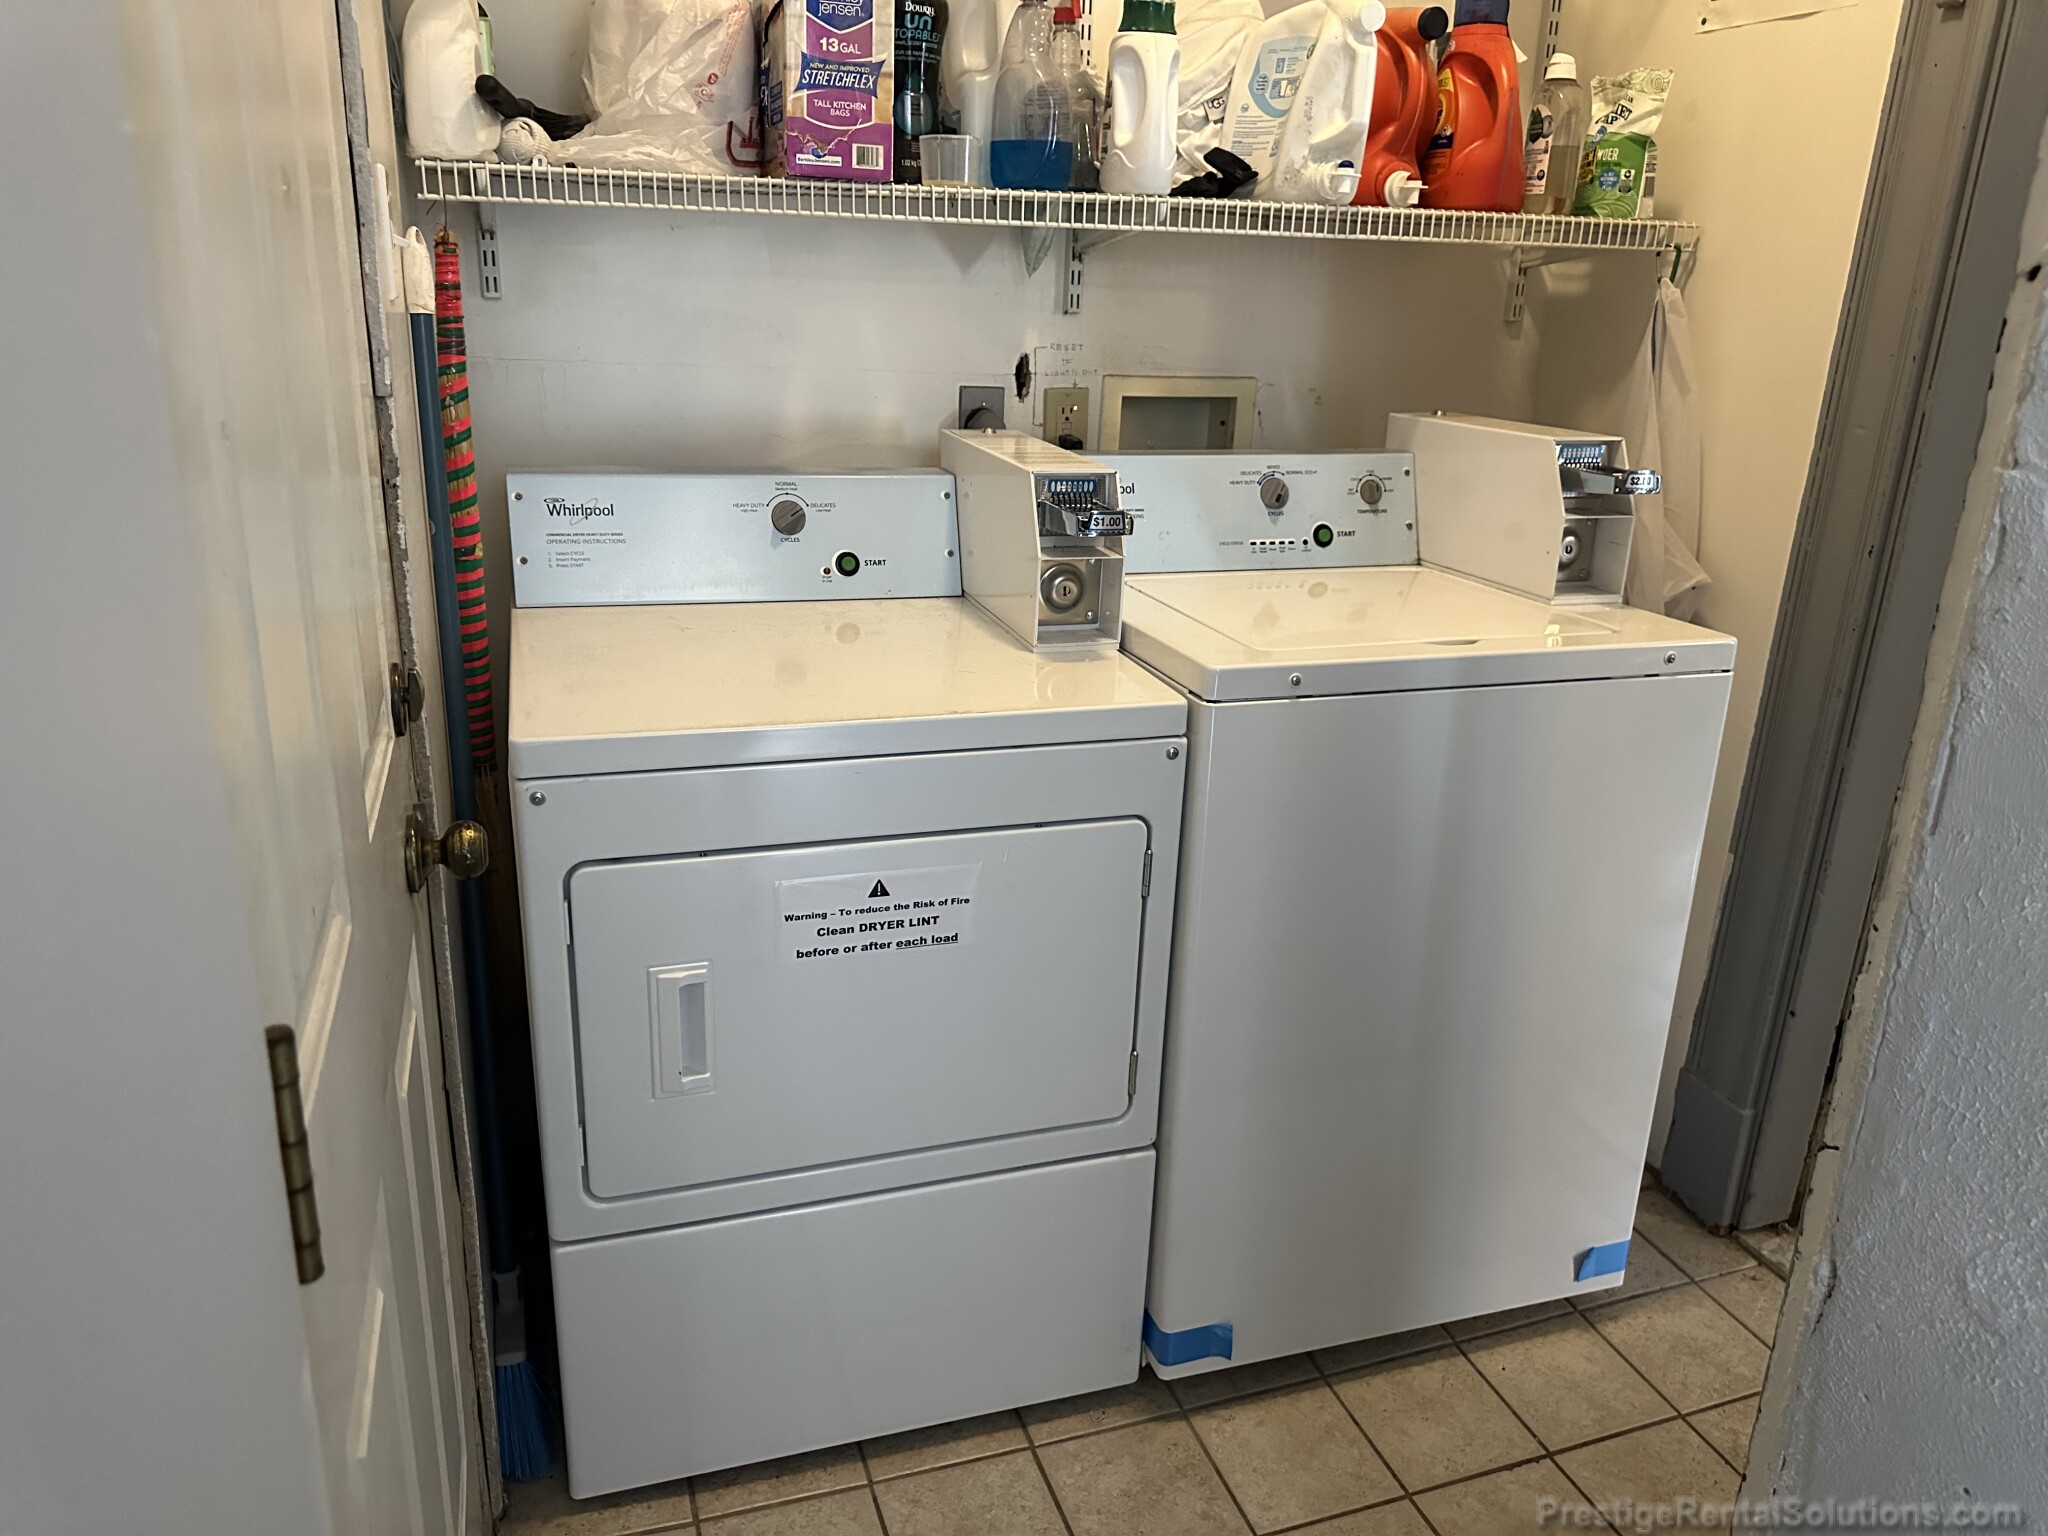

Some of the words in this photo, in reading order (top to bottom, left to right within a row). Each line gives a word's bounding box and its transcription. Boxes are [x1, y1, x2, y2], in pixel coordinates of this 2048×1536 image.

[818, 3, 861, 16] jensen
[906, 2, 935, 16] Downy
[820, 37, 838, 52] 13
[840, 44, 861, 54] GAL
[840, 65, 870, 73] IMPROVED
[802, 69, 876, 89] STRETCHFLEX
[813, 99, 832, 107] TALL
[833, 101, 866, 110] KITCHEN
[830, 108, 850, 117] BAGS
[1050, 342, 1084, 351] RESET
[1061, 358, 1074, 366] IF
[546, 504, 614, 520] Whirlpool
[1093, 517, 1120, 526] $1.00
[784, 911, 828, 922] Warning
[854, 904, 890, 914] reduce
[913, 900, 935, 909] Risk
[938, 898, 948, 906] of
[951, 897, 970, 905] Fire
[816, 925, 854, 937] Clean
[859, 920, 905, 933] DRYER
[909, 916, 940, 928] LINT
[796, 947, 839, 959] before
[843, 945, 857, 954] or
[861, 940, 892, 952] after
[896, 937, 927, 948] each
[931, 933, 958, 944] load
